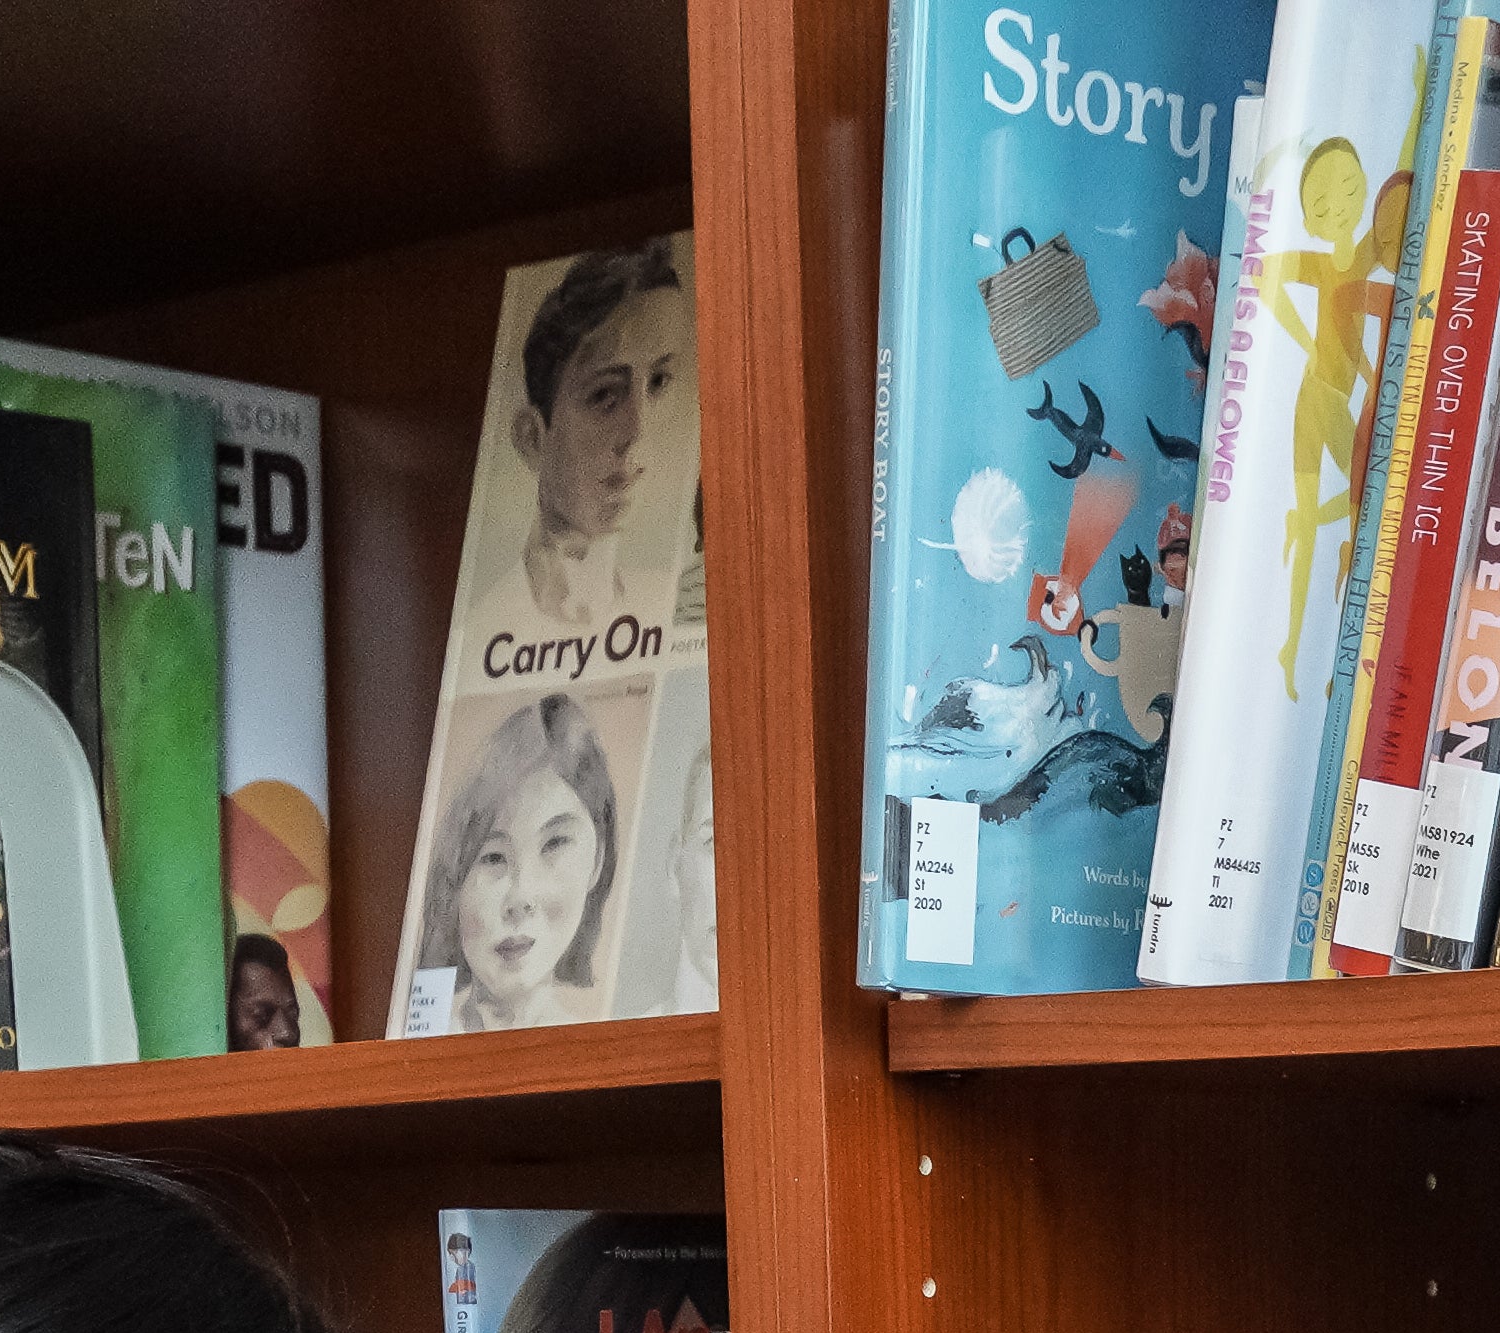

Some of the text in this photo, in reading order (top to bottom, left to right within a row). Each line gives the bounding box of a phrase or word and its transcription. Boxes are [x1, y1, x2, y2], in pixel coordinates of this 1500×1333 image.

[983, 8, 1217, 197] Story
[1242, 188, 1275, 279] TIME
[1411, 211, 1490, 545] SKATING OVER THIN ICE
[871, 347, 892, 542] STORY BOAT
[483, 615, 662, 681] Carry On
[917, 822, 930, 835] PZ
[915, 859, 954, 874] M2246
[1083, 866, 1129, 887] Words
[1412, 863, 1438, 879] 2021
[1344, 880, 1369, 895] 2018
[914, 898, 942, 911] 2020
[1209, 896, 1233, 909] 2021
[1050, 906, 1109, 927] Pictures
[1149, 913, 1161, 954] tundra
